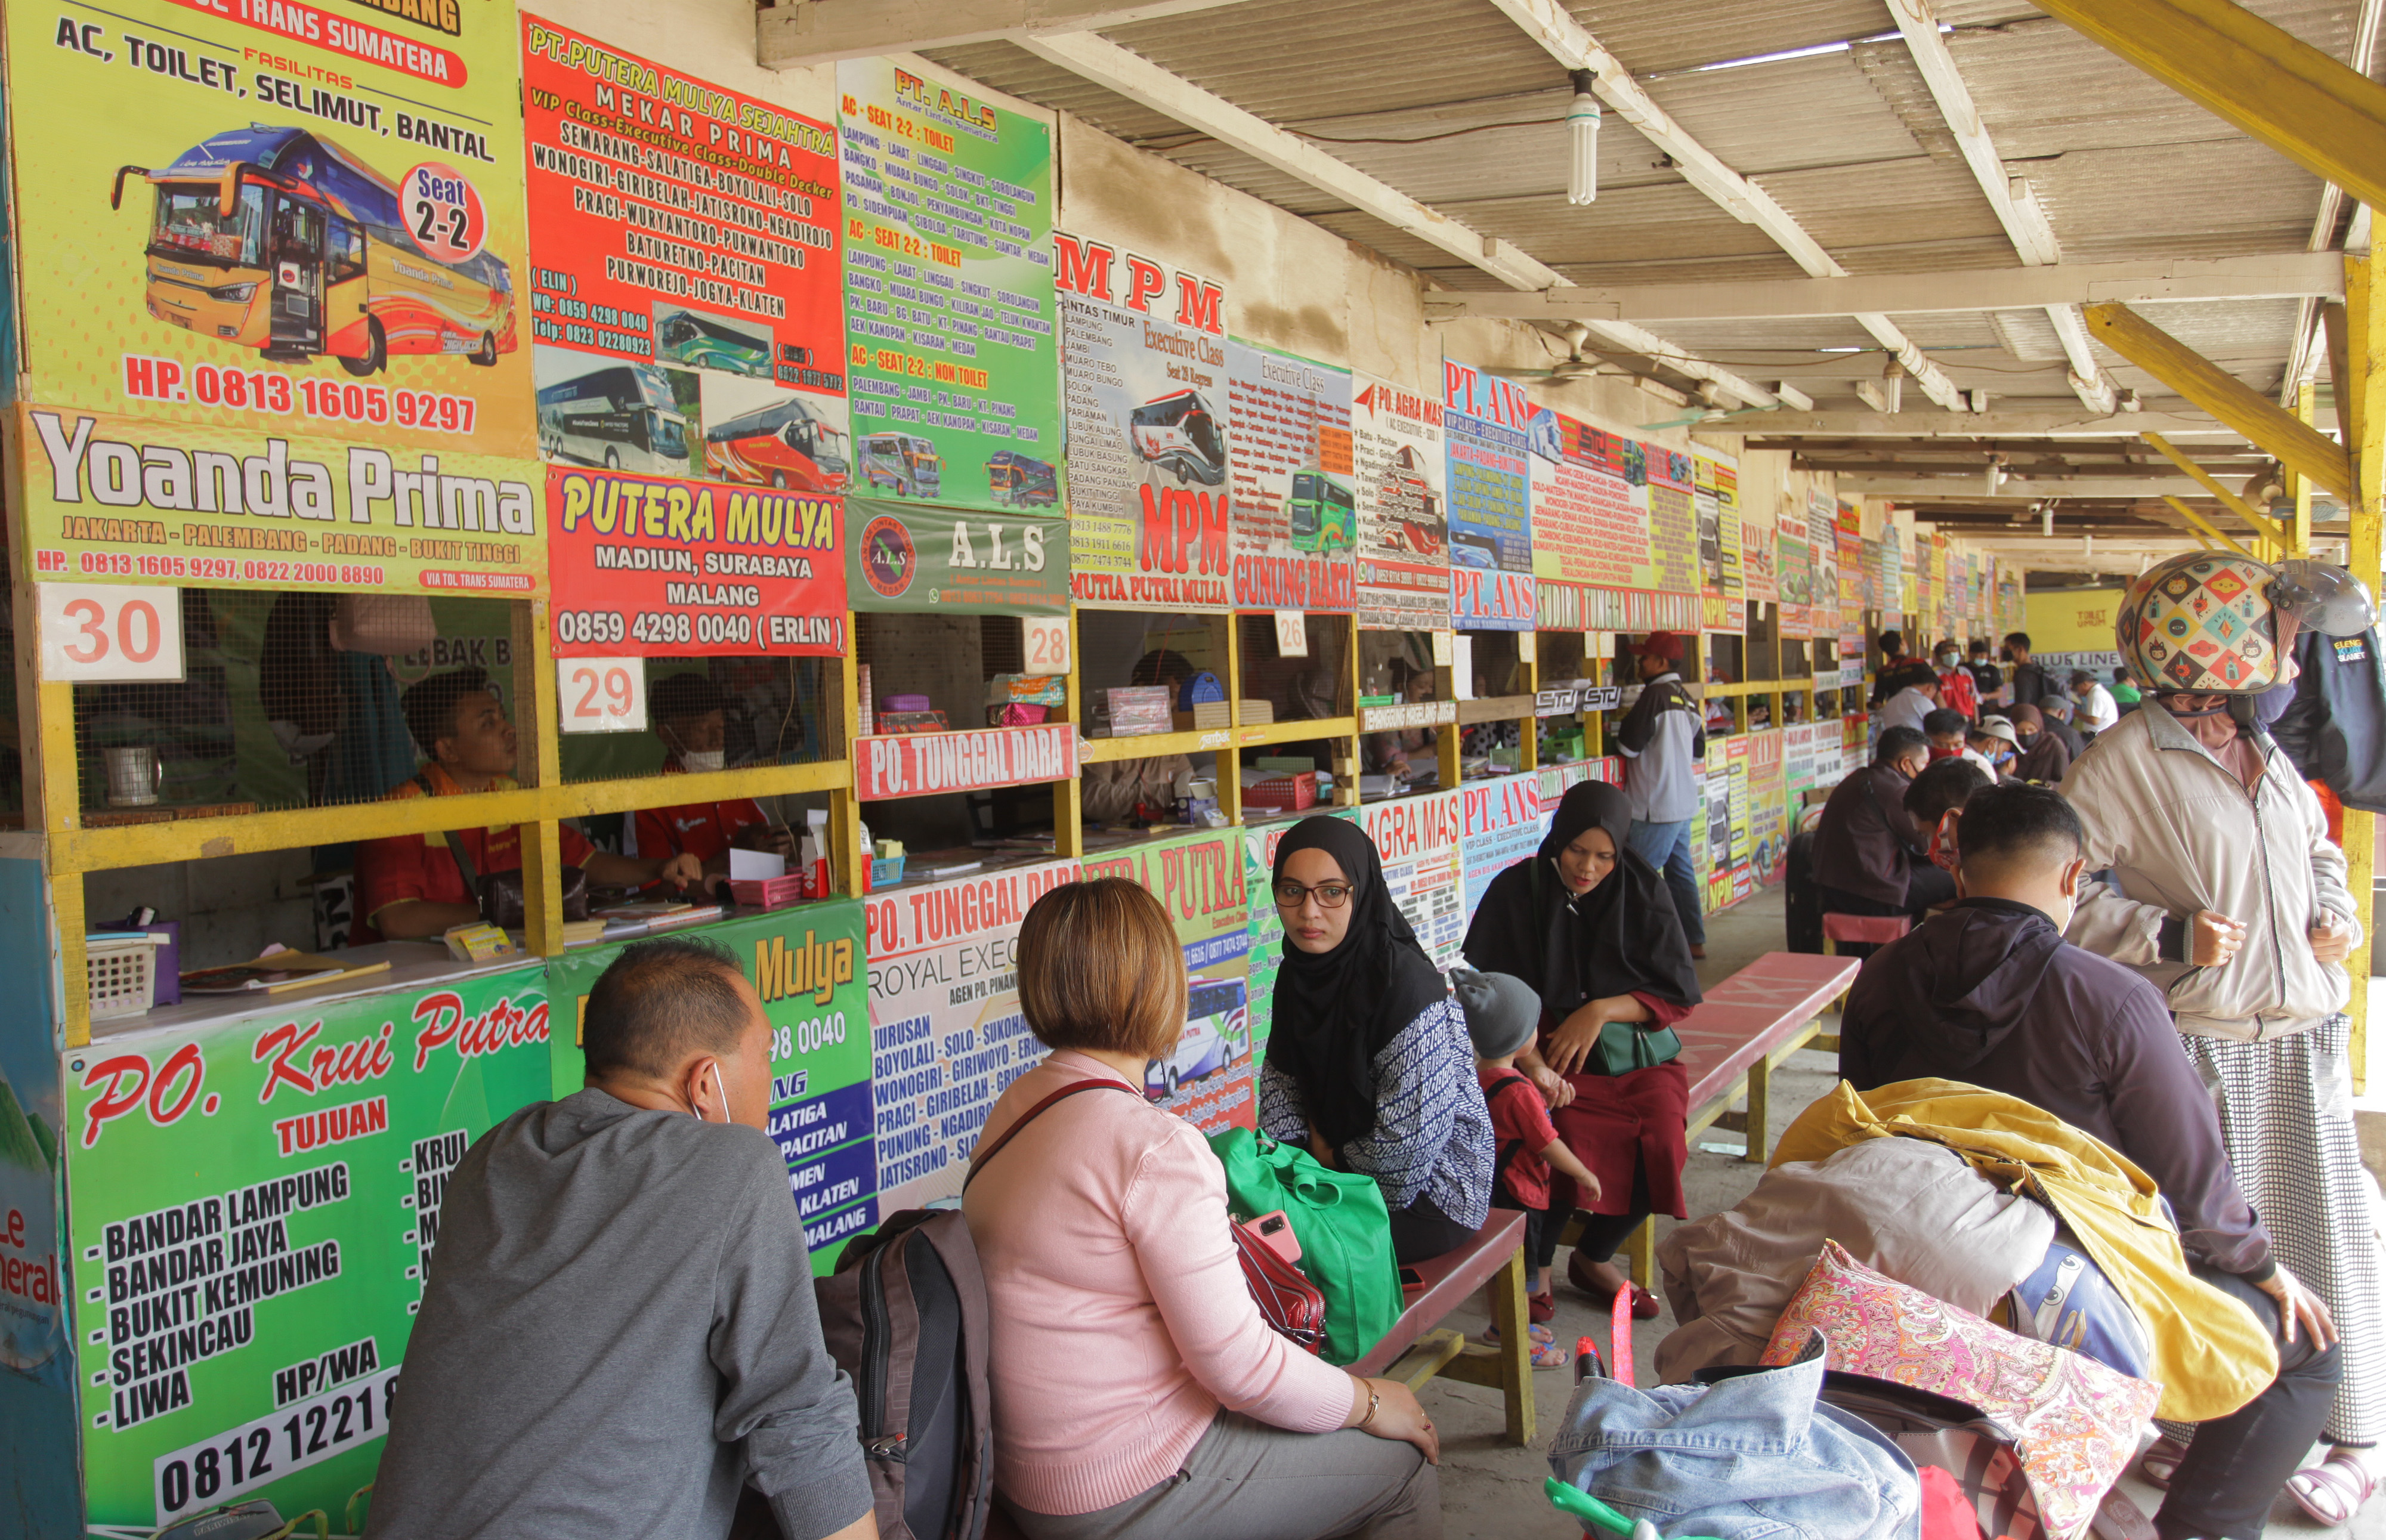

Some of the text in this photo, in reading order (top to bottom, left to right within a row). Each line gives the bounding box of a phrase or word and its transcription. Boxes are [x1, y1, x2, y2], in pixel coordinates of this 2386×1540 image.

[244, 47, 353, 89] FASILITAS
[327, 20, 448, 81] SUMATERA
[57, 18, 495, 162] AC, TOILET, SELIMUT, BANTAL
[894, 67, 997, 132] PT. A.L.S
[596, 83, 792, 170] MEKAR PRIMA
[663, 75, 736, 123] MULYA
[740, 103, 835, 157] SEJAHTRA
[842, 95, 955, 154] AC SEAT 2-2 TOILET
[843, 125, 880, 150] LAMPUNG
[895, 96, 999, 144] Antar Lintas Sumatera
[531, 88, 833, 200] VIP Class-Executive Class-Double Decker
[418, 169, 466, 206] Seat
[416, 202, 469, 249] 2-2
[391, 258, 429, 282] Yoanda
[431, 273, 454, 289] Prima
[532, 317, 651, 356] Telp: 0823 02280923
[559, 296, 588, 321] 0859
[591, 302, 619, 325] 4298
[621, 308, 647, 332] 0040
[1065, 313, 1103, 332] LAMPUNG
[1066, 327, 1112, 347] PALEMBANG
[1102, 309, 1135, 328] TIMUR
[1143, 320, 1224, 367] Executive Class
[127, 358, 475, 433] HP. 0813 1605 9297
[1262, 355, 1302, 388] Executive
[1302, 367, 1325, 394] Class
[1444, 360, 1528, 433] PT. ANS
[1379, 386, 1393, 413] PO.
[1396, 392, 1421, 421] AGRA
[1423, 400, 1443, 427] MAS
[1360, 429, 1398, 447] Batu Pacitan
[30, 410, 536, 536] Yoanda Prima
[561, 474, 835, 551] PUTERA MULYA
[1139, 483, 1229, 576] MPM
[63, 517, 520, 563] JAKARTA PALEMBANG PADANG BUKIT TINGGI
[595, 545, 812, 579] MADIUN, SURABAYA
[871, 551, 906, 565] A.L.S
[948, 521, 1044, 571] A.L.S
[37, 550, 384, 585] HP. 0813 1605 9297, 0822 2000 8890
[426, 573, 529, 589] VIA TOL TRANS SUMATERA
[1070, 573, 1128, 601] MUTIA
[1130, 576, 1179, 603] PUTRI
[1182, 579, 1228, 604] MULIA
[1233, 555, 1306, 607] GUNUNG
[1308, 559, 1358, 608] HARTA
[666, 582, 760, 607] MALANG
[1452, 570, 1489, 616] PT.
[1493, 573, 1534, 619] ANS
[1536, 583, 1627, 630] SUDIRO TUNGGA
[63, 599, 160, 664] 30
[558, 611, 830, 644] 0859 4298 0040 ERLIN
[1031, 628, 1064, 664] 28
[1280, 619, 1302, 648] 26
[2334, 639, 2363, 650] ELENG
[2337, 646, 2362, 655] KUAT
[2079, 653, 2118, 665] LINE
[2338, 652, 2365, 661] SLAMET
[574, 668, 633, 717] 29
[870, 729, 1064, 794] PO. TUNGGAL DARA
[1367, 804, 1418, 861] AGRA
[1423, 794, 1458, 851] MAS
[1464, 778, 1538, 837] PT. ANS
[1160, 835, 1247, 922] PUTRA
[866, 876, 1022, 955] PO. TUNGGAL
[756, 929, 853, 1007] Mulya
[868, 955, 951, 999] ROYAL
[950, 984, 972, 1006] AGEN
[798, 1010, 846, 1055] 0040
[874, 1016, 930, 1052] JURUSAN
[874, 1029, 974, 1079] BOYOLALI SOLO
[84, 994, 549, 1146] PO. Krui Putra
[874, 1044, 1009, 1106] WONOGIRI GIRIWOYO
[277, 1099, 387, 1154] TUJUAN
[877, 1078, 988, 1135] PRACI GIRIBELAH
[781, 1121, 847, 1158] PACITAN
[878, 1124, 931, 1162] PUNUNG
[880, 1145, 947, 1191] JATISRONO
[106, 1165, 348, 1263] BANDAR LAMPUNG
[801, 1177, 859, 1216] KLATEN
[805, 1207, 866, 1247] MALANG
[108, 1222, 286, 1304] BANDAR JAYA
[111, 1242, 339, 1345] BUKIT KEMUNING
[113, 1312, 252, 1384] SEKINCAU
[277, 1340, 377, 1405] HP/WA
[115, 1371, 190, 1430] LIWA
[162, 1386, 373, 1513] 0812 1221
